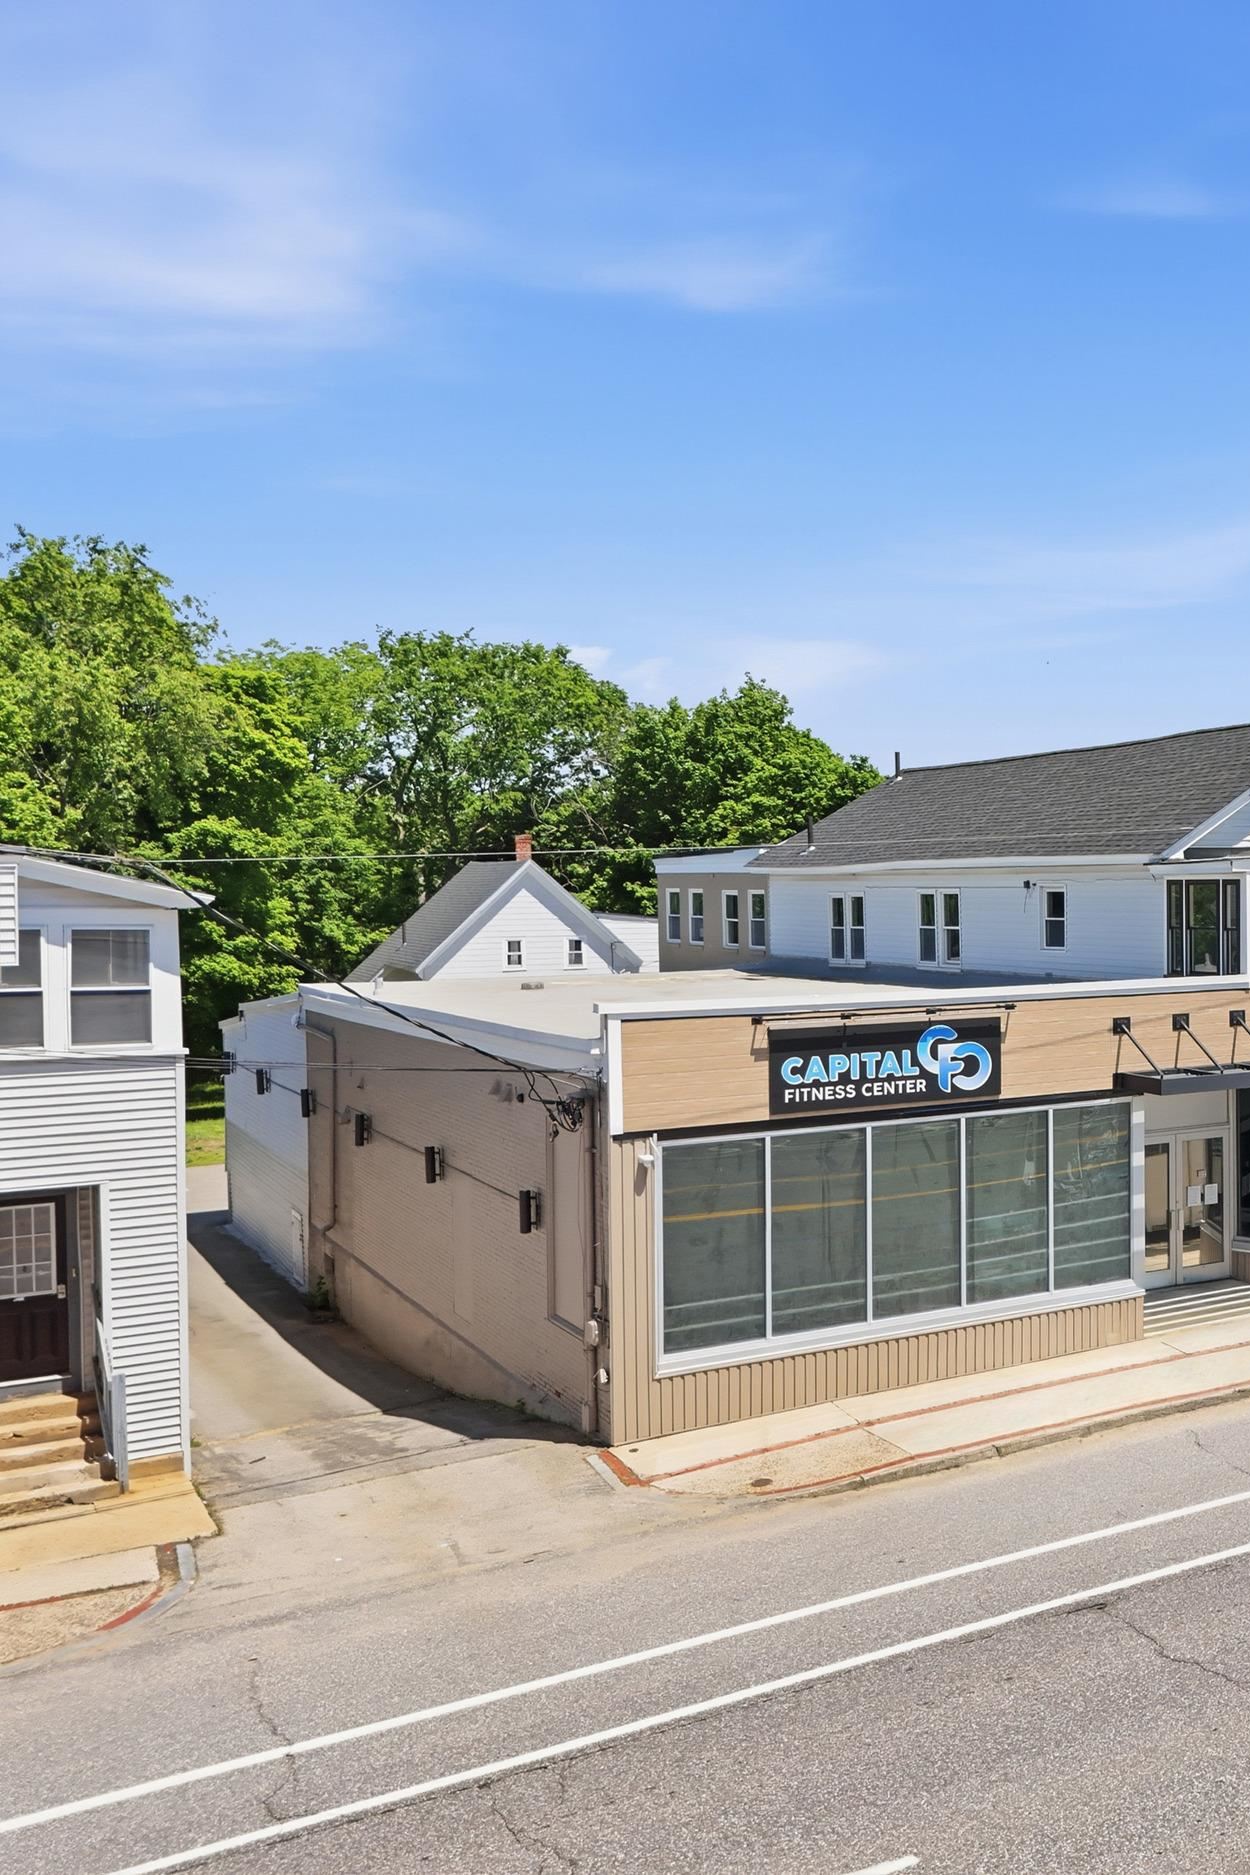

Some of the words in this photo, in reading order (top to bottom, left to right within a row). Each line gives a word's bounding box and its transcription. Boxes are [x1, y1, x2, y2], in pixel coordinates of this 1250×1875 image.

[781, 1049, 920, 1085] CAPITAL
[784, 1084, 857, 1103] FITNESS
[861, 1079, 927, 1097] CENTER
